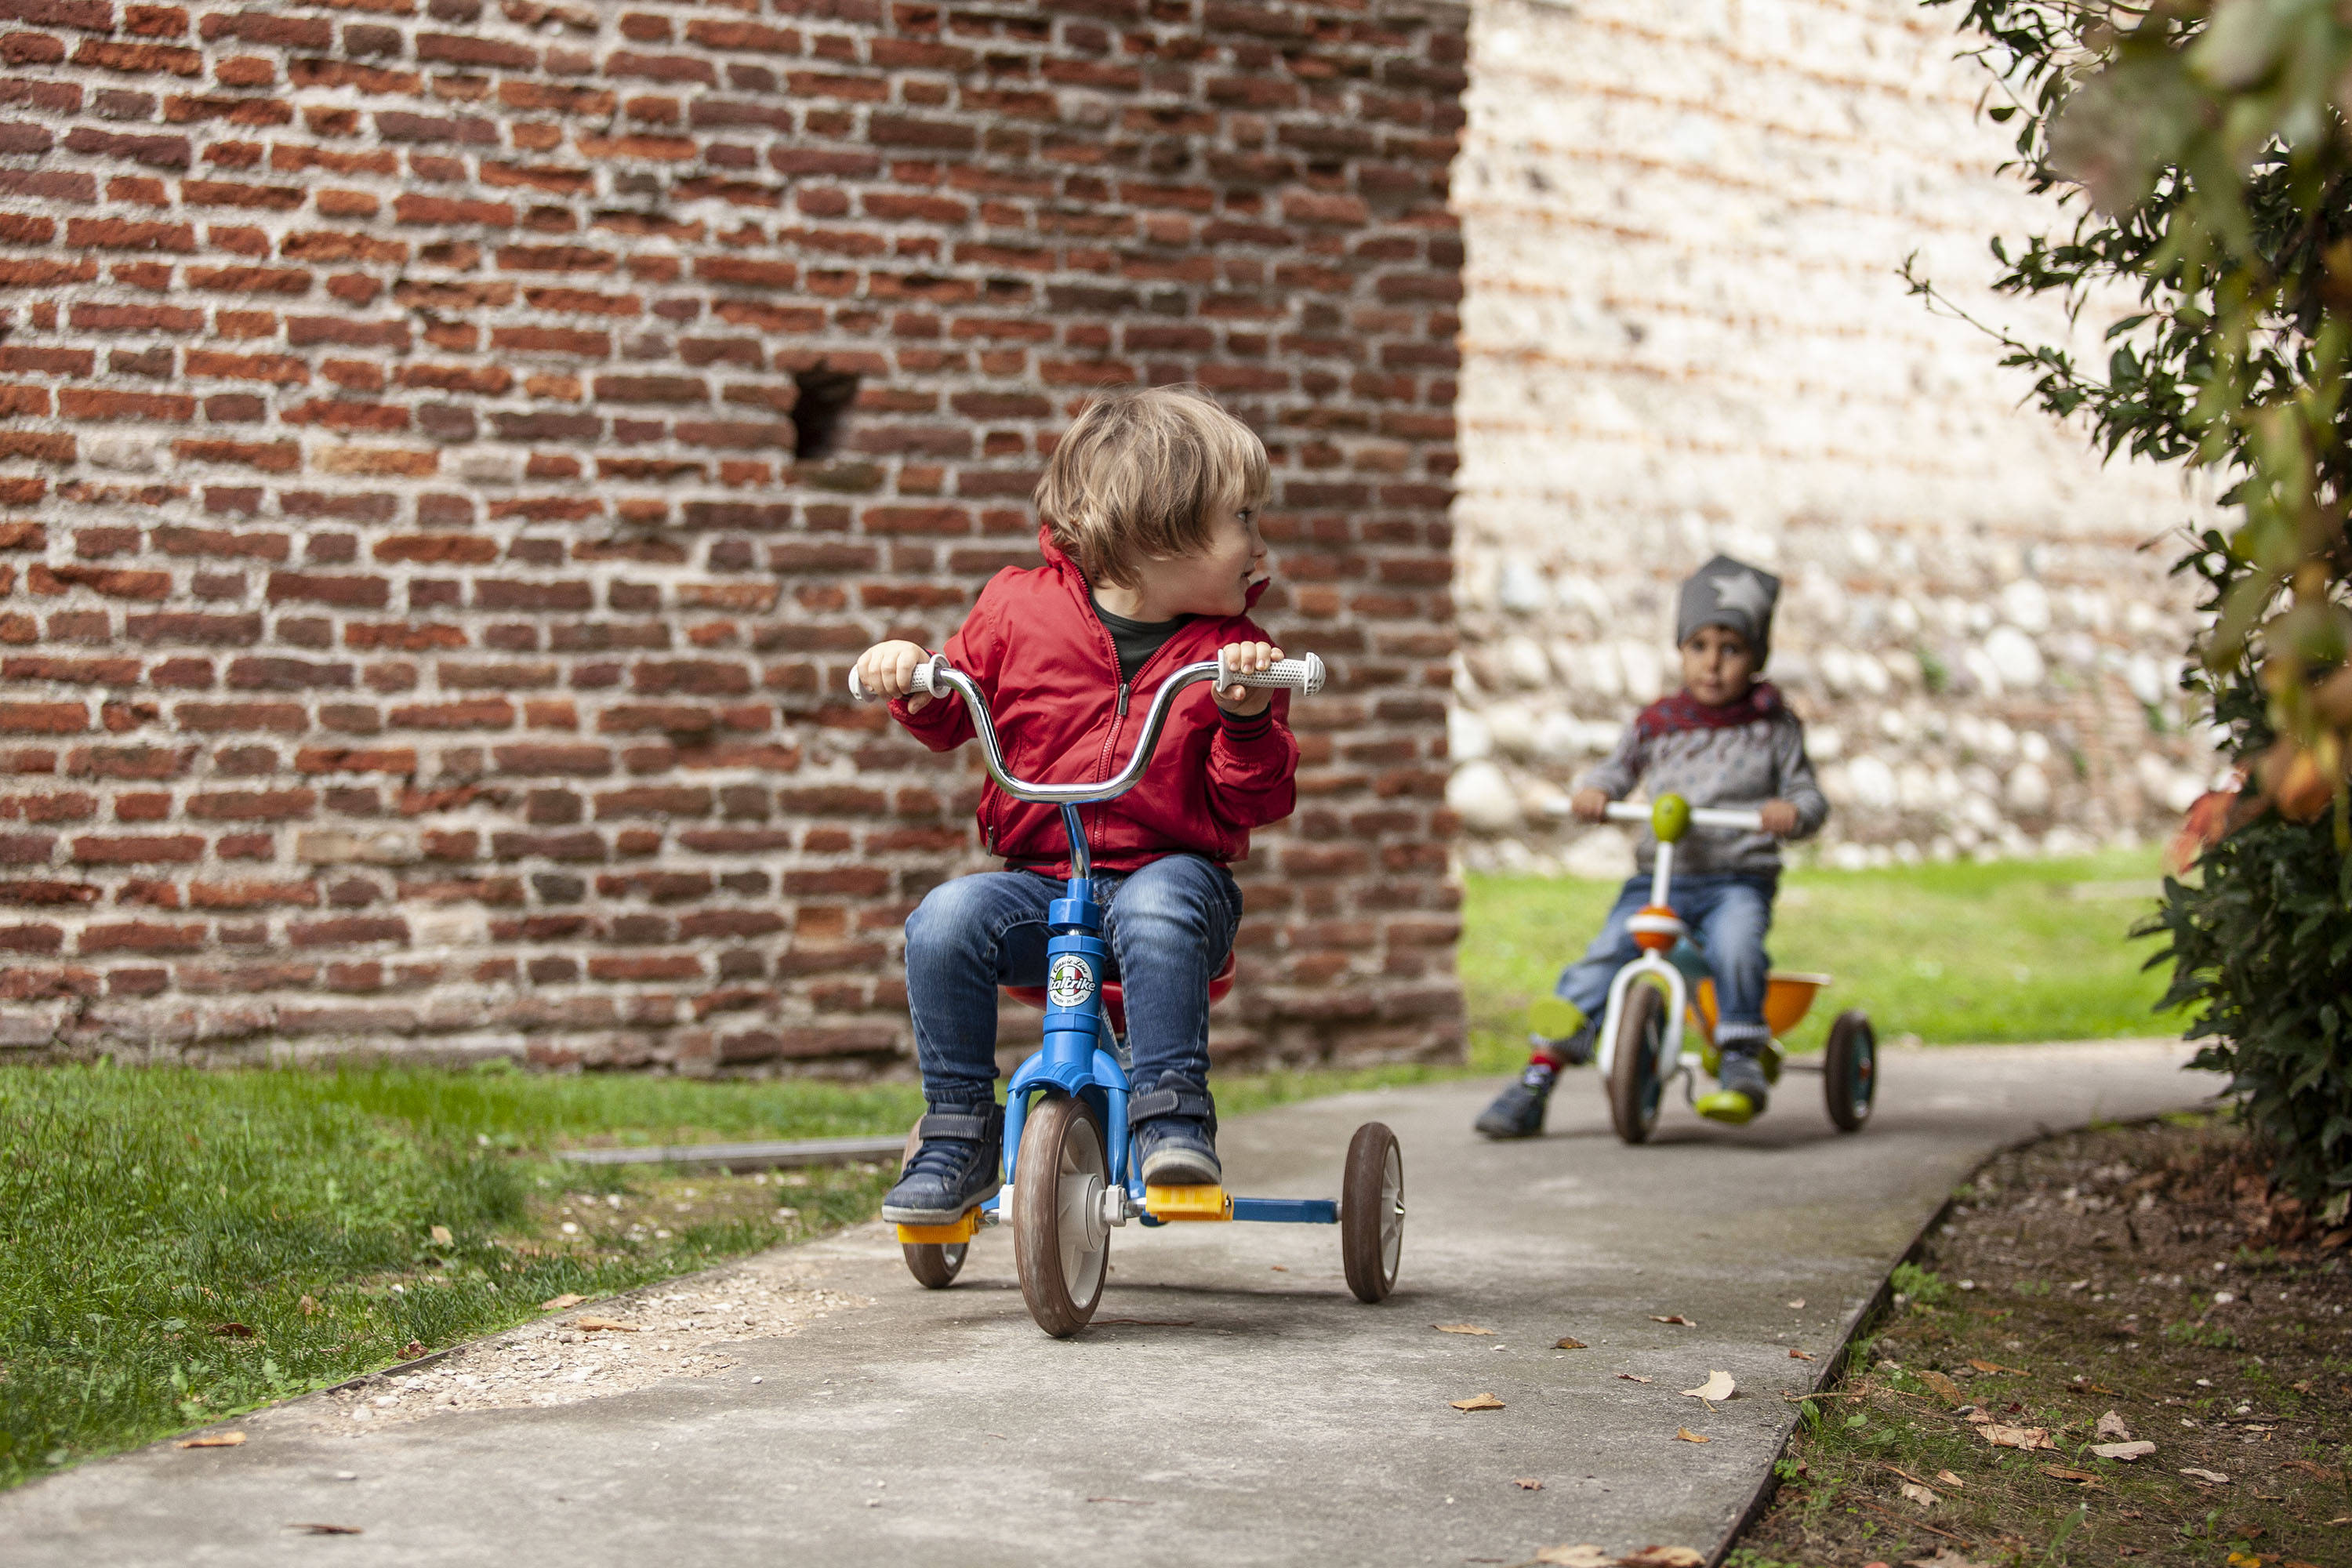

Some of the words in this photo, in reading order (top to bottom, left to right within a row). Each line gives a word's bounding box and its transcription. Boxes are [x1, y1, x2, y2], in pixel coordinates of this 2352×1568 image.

[1054, 958, 1073, 973] Classic
[1073, 960, 1087, 974] Line
[1053, 994, 1064, 1003] Made
